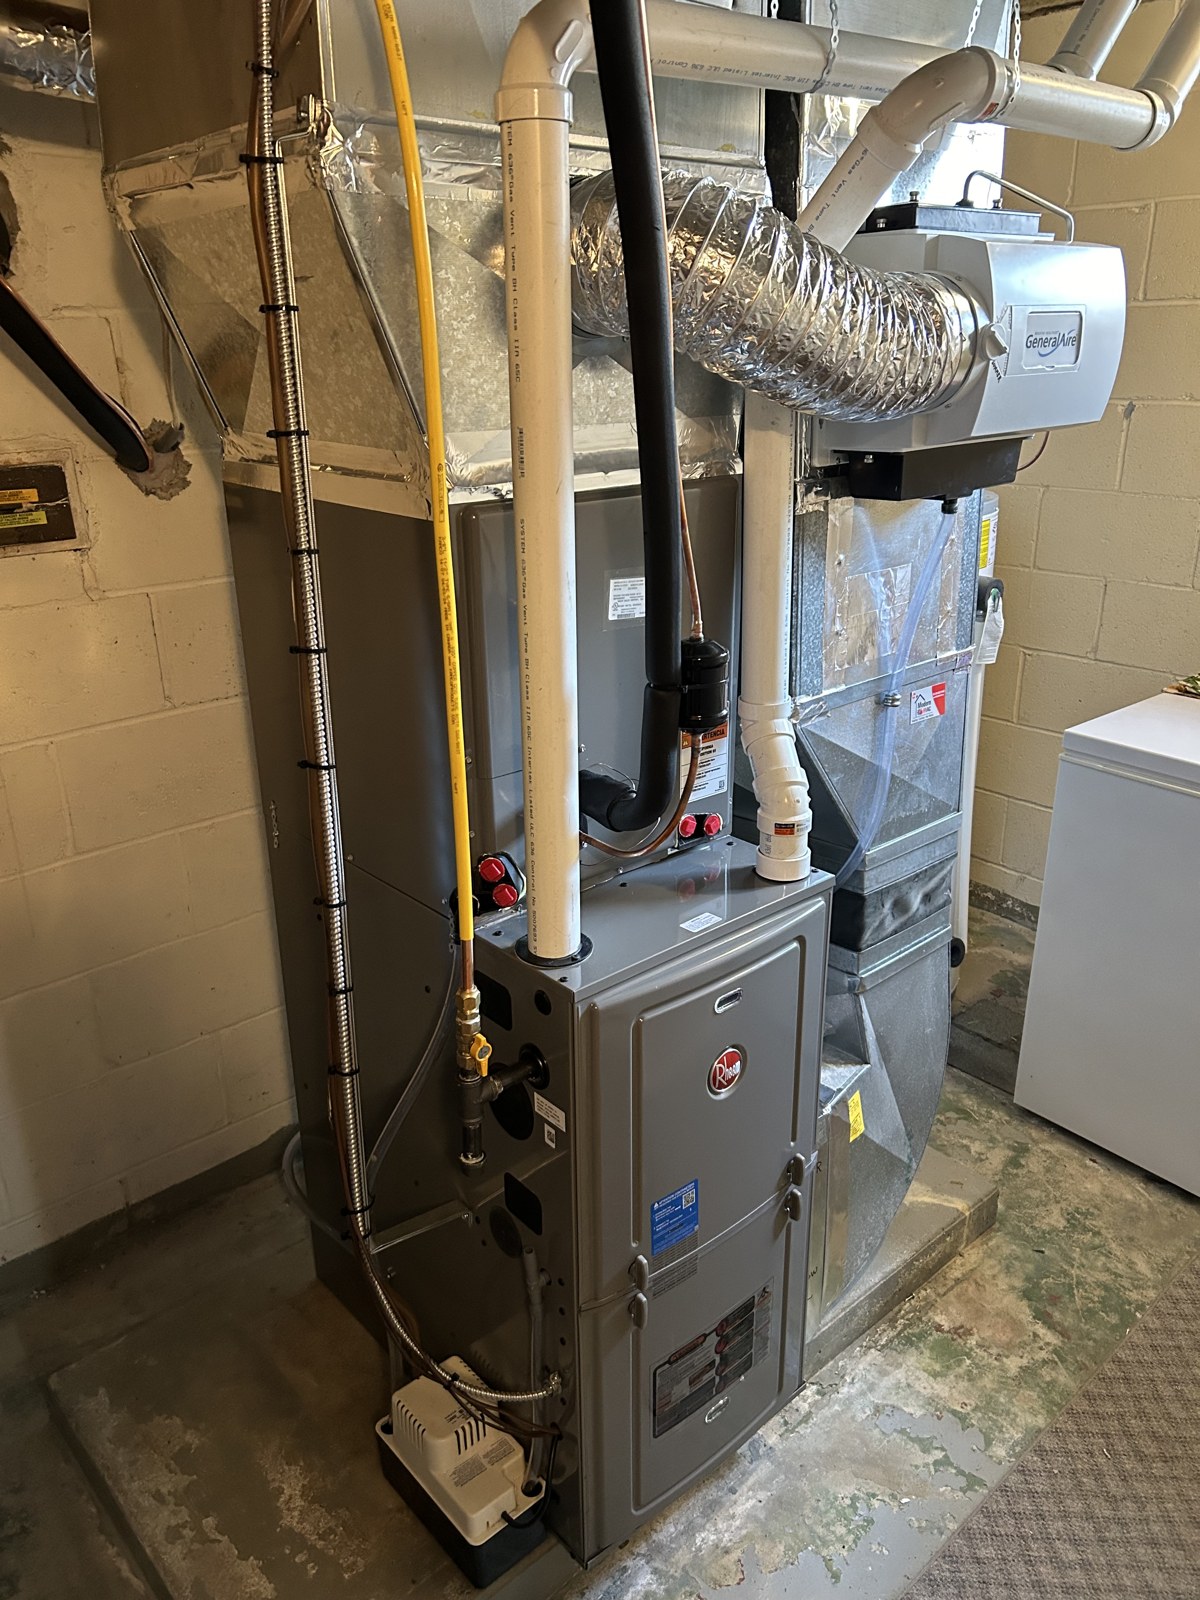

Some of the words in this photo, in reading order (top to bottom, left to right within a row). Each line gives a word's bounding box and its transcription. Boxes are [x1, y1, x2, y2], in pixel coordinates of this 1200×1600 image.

[657, 59, 688, 68] Control
[722, 67, 748, 76] Listed
[751, 71, 782, 80] Intertek
[832, 180, 848, 198] Vent
[815, 202, 830, 221] Type
[1025, 330, 1077, 350] GeneralAire
[918, 700, 932, 708] Modern
[531, 896, 536, 906] No
[715, 1056, 740, 1088] Rheem
